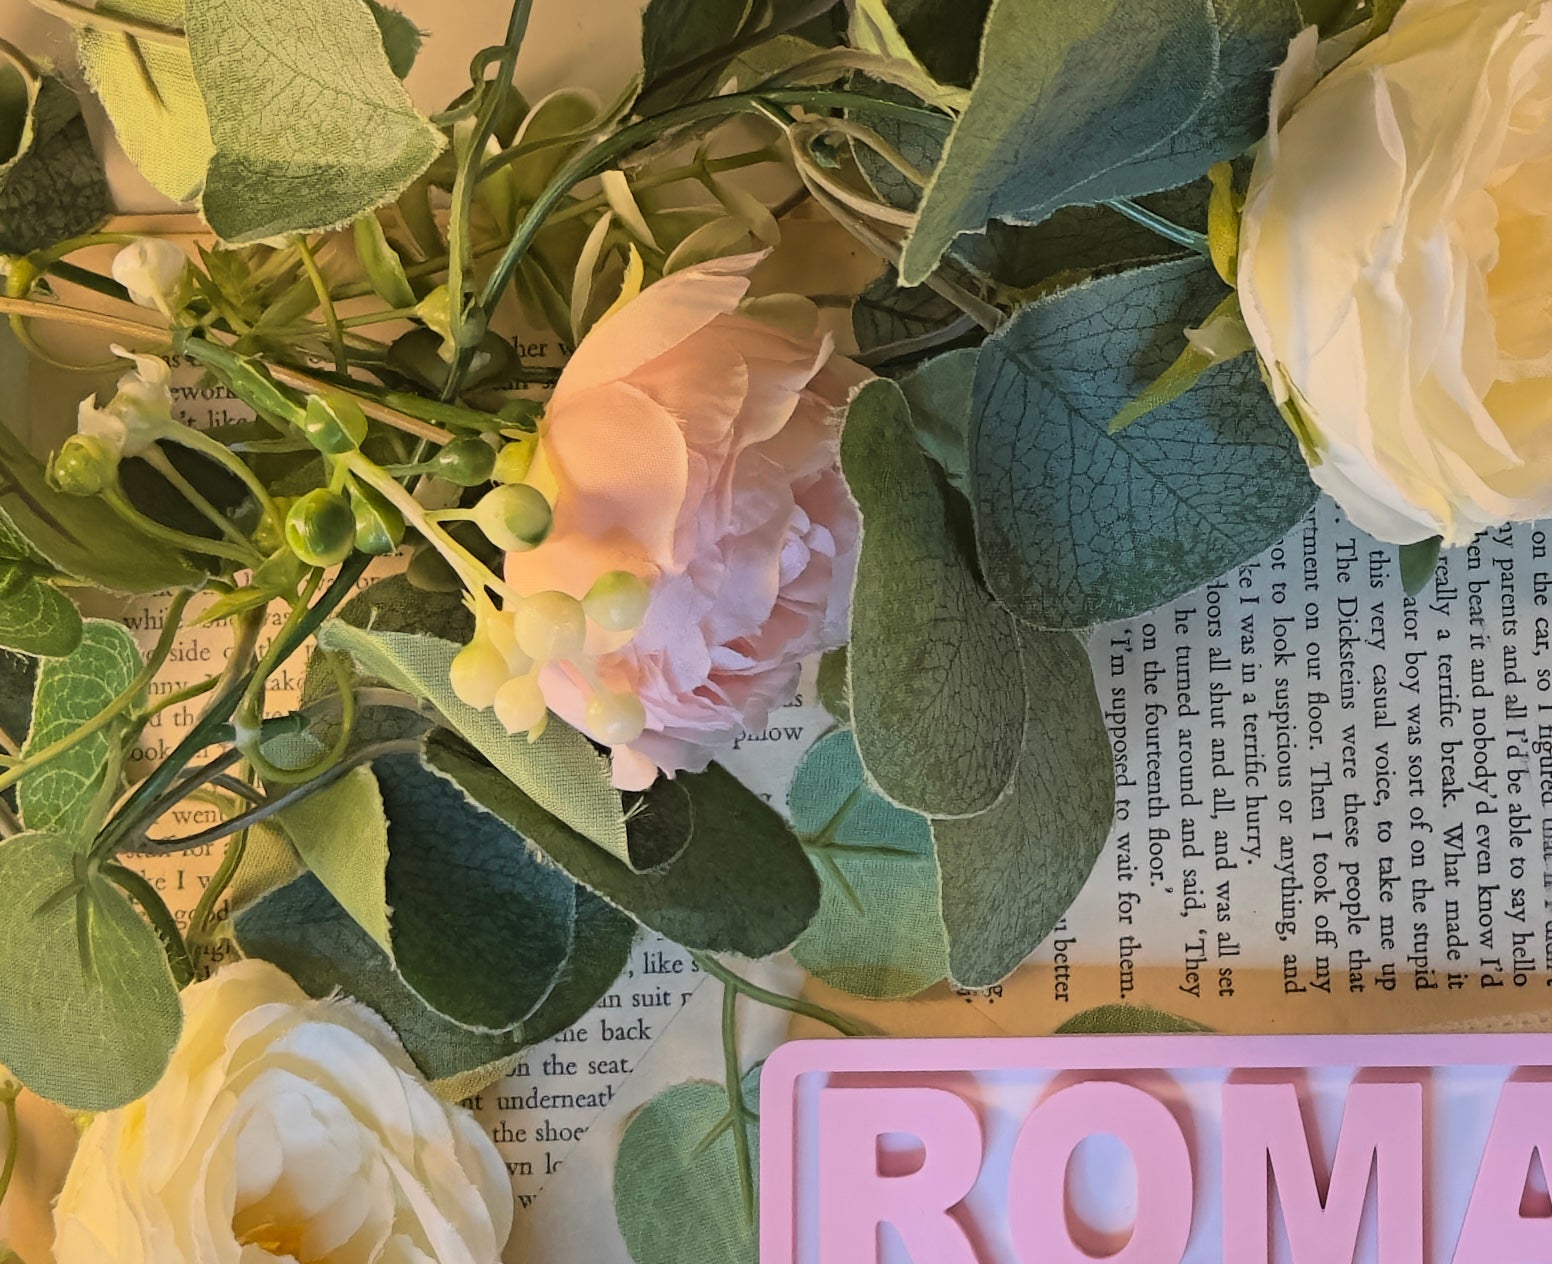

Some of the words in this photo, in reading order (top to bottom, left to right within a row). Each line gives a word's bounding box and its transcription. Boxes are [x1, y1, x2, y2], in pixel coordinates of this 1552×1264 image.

[1335, 537, 1358, 581] The
[1141, 622, 1157, 653] on
[1336, 594, 1362, 710] Dicksteins
[1142, 659, 1167, 696] the
[1103, 686, 1138, 788] supposed
[1340, 722, 1357, 780] were
[1143, 701, 1171, 820] fourteenth
[1112, 798, 1132, 822] to
[1342, 791, 1367, 849] these
[1115, 830, 1139, 883] wait
[1147, 826, 1174, 895] floor.'
[1116, 890, 1142, 926] for
[1336, 860, 1371, 936] people
[641, 950, 684, 975] like
[1117, 934, 1143, 1000] them.
[1347, 947, 1373, 994] that
[631, 985, 672, 1008] suit
[599, 1016, 653, 1042] back
[541, 1052, 578, 1077] the
[490, 1119, 528, 1148] the
